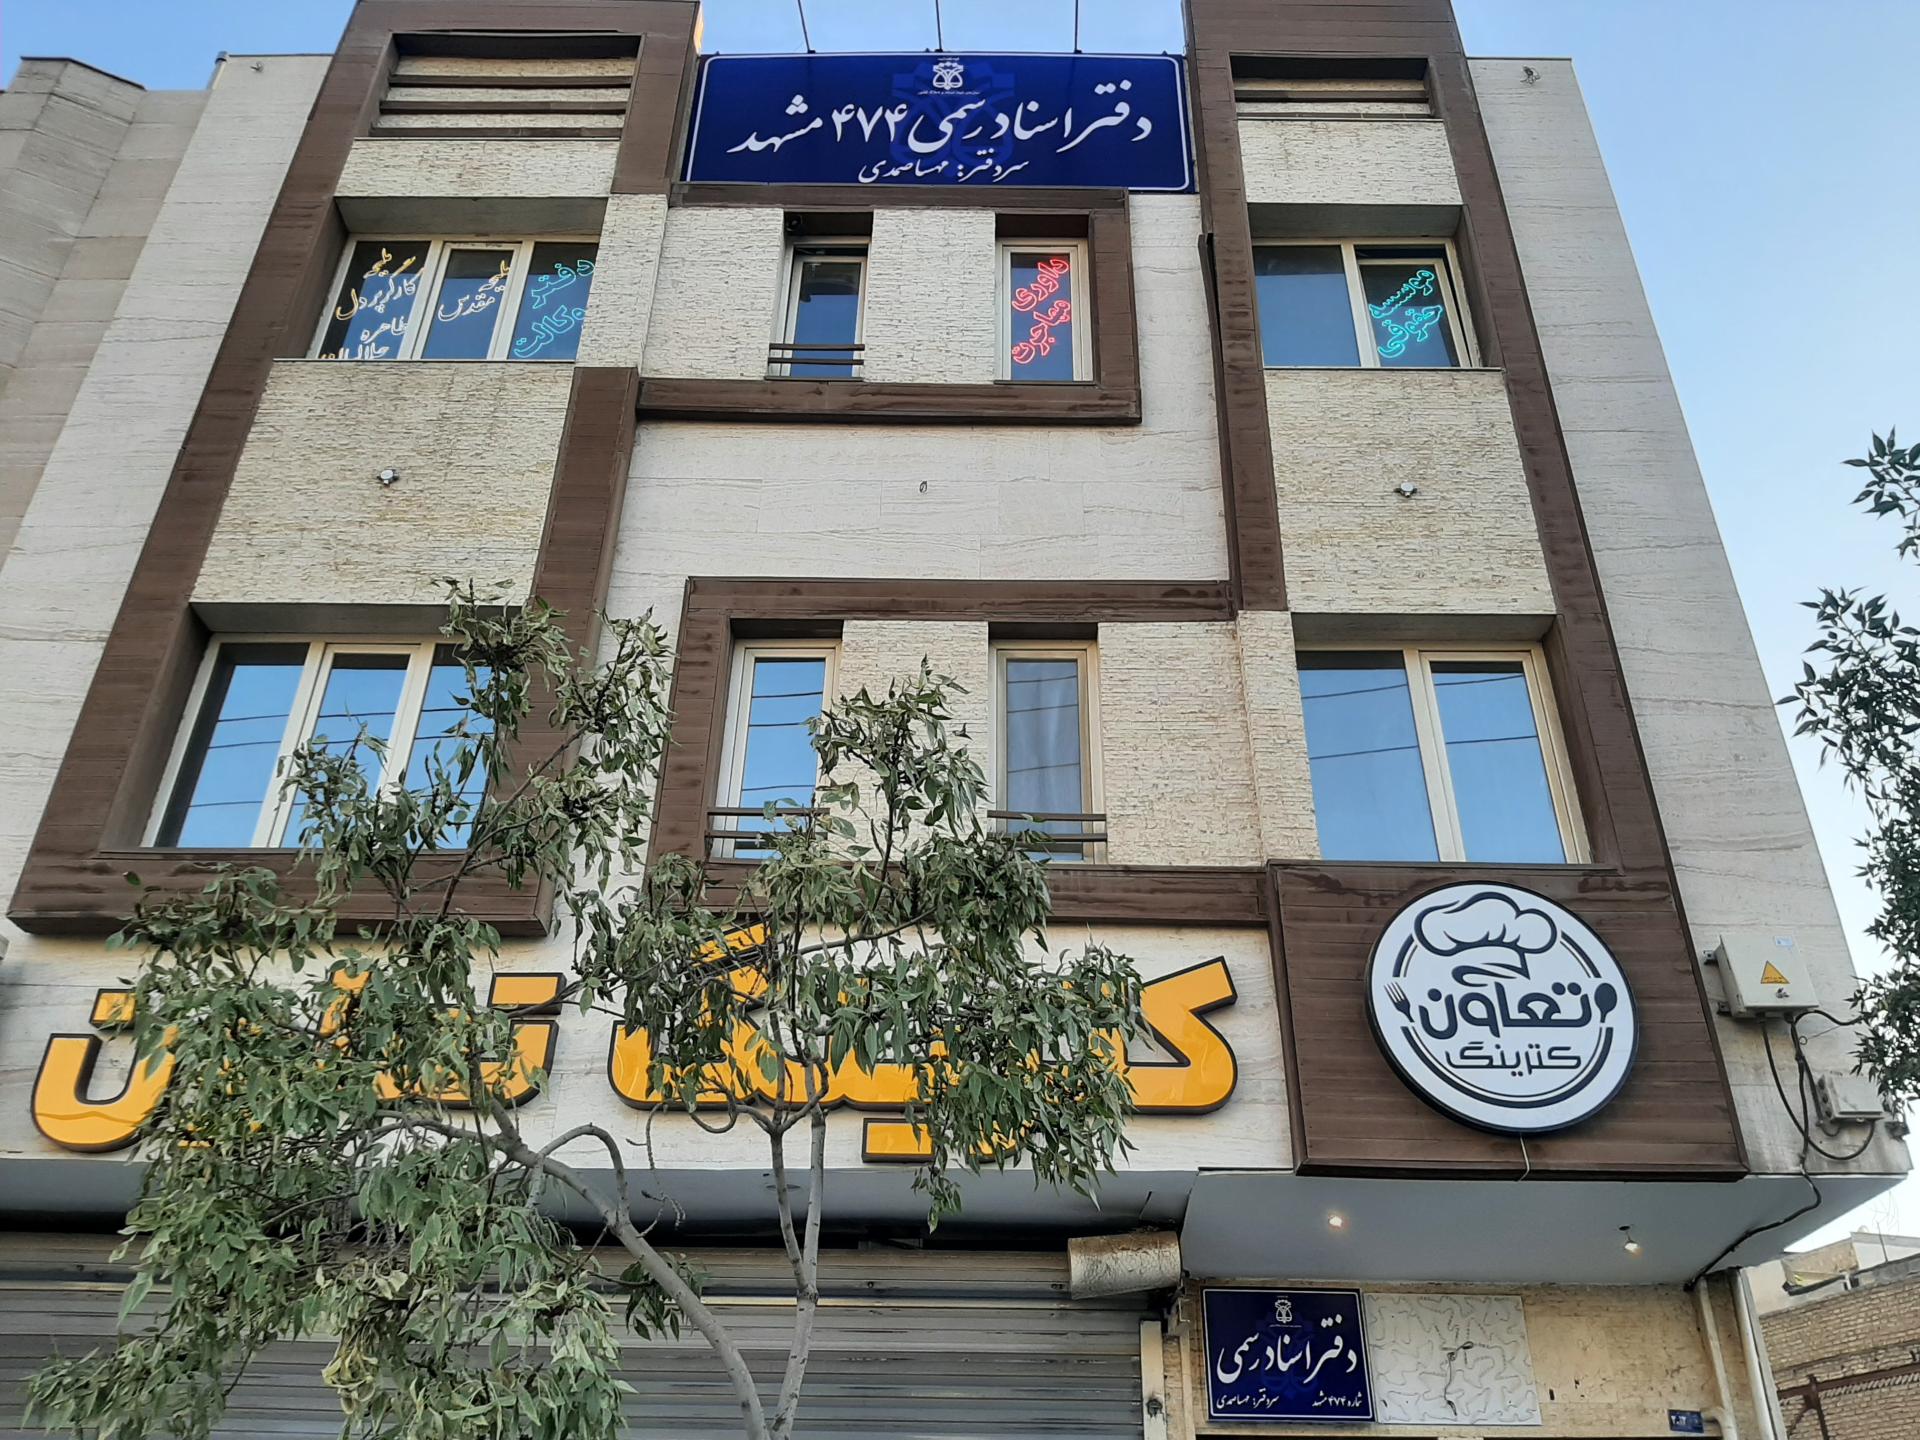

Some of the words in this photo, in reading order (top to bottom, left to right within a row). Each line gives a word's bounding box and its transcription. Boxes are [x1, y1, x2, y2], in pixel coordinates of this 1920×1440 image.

[726, 95, 823, 153] مشهد
[831, 103, 907, 144] ۴۷۴
[908, 98, 988, 153] رسمی
[993, 101, 1073, 141] اسناد
[1056, 80, 1152, 153] دفتر
[858, 160, 913, 183] صمدی
[914, 158, 949, 177] مهسا
[531, 260, 595, 309] دفتر
[1012, 259, 1069, 311] داوری
[514, 305, 587, 358] وکالت
[1377, 305, 1443, 358] حقوقی
[1418, 982, 1592, 1040] تعاون
[1445, 1041, 1582, 1077] کترینگ
[1217, 1333, 1260, 1384] رسمی
[1265, 1334, 1311, 1372] اسناد
[1303, 1314, 1357, 1384] دفتر
